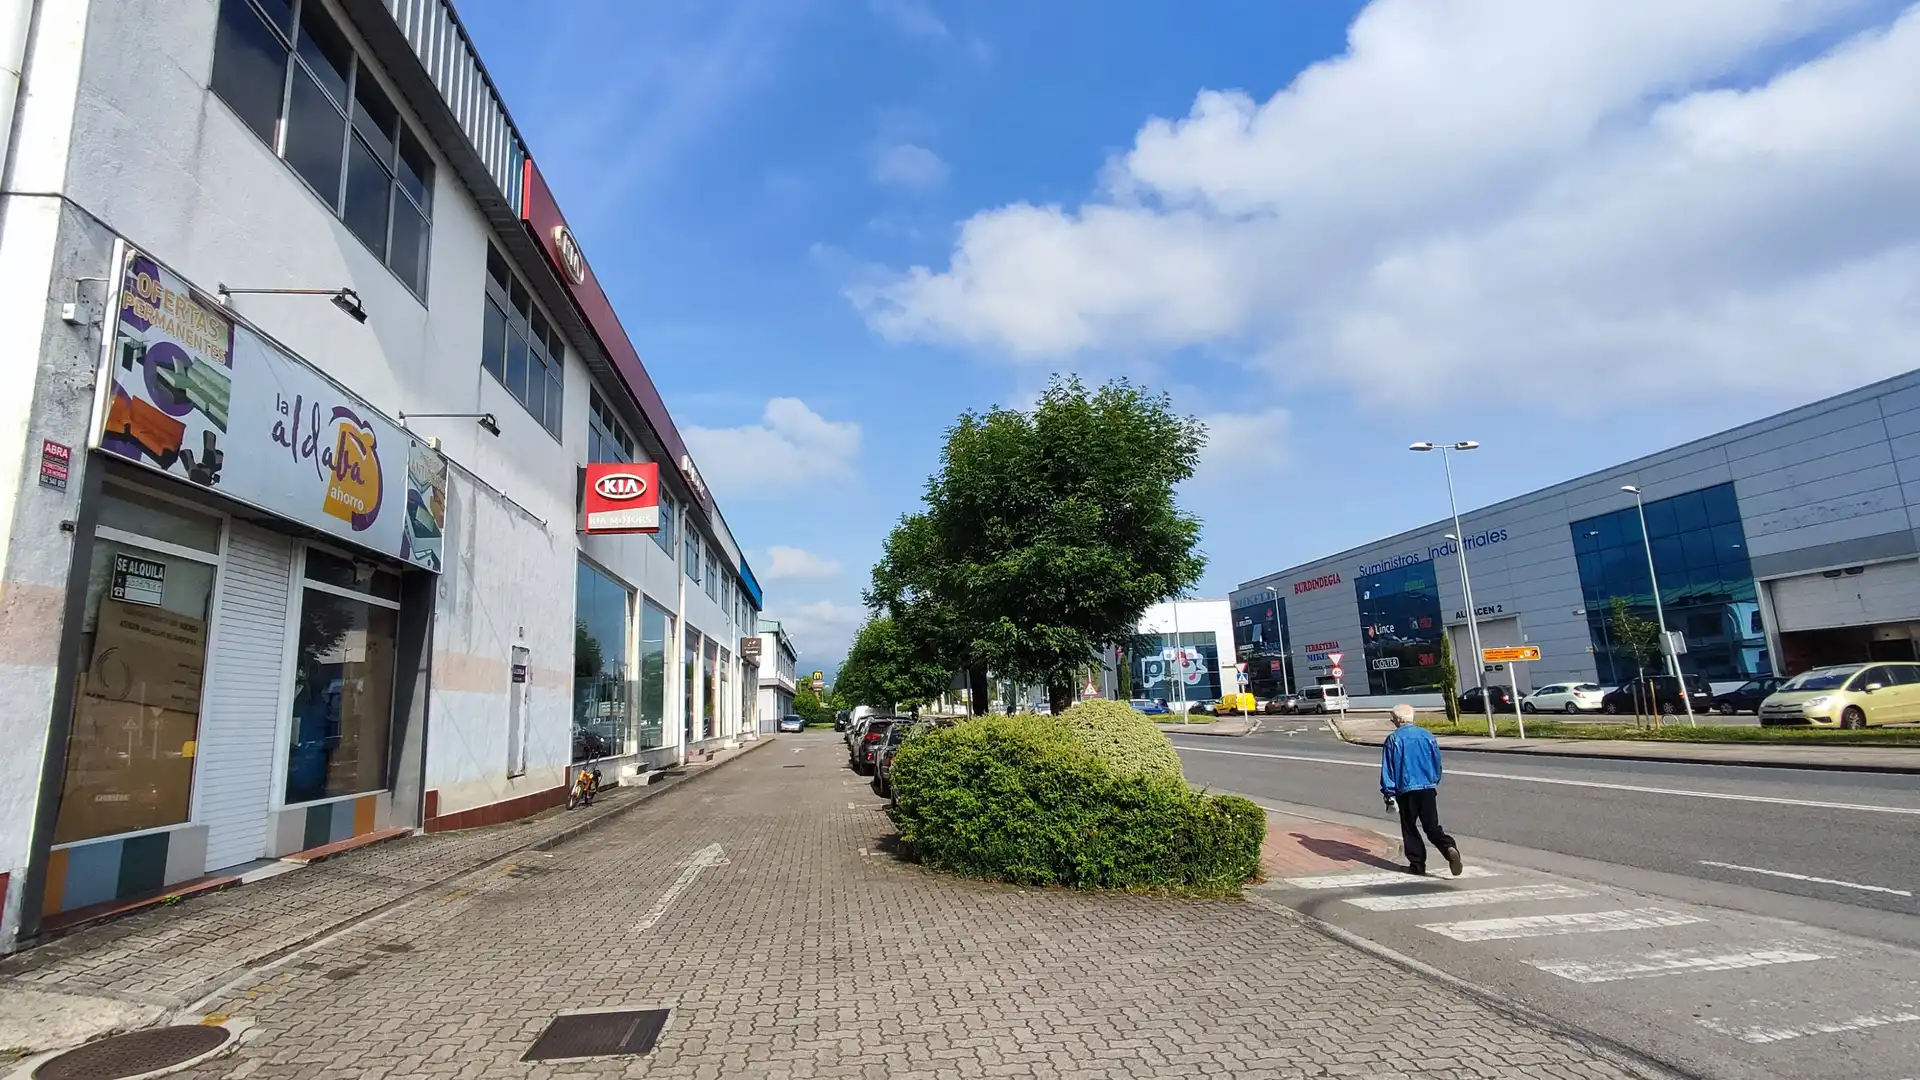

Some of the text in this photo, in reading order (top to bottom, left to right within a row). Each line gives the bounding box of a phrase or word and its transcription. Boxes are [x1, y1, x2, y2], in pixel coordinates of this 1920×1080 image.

[136, 272, 220, 341] OFERTAS
[122, 291, 227, 365] PERMANENTES
[277, 393, 288, 416] la
[272, 395, 365, 485] aldaba
[45, 443, 69, 459] ABRA
[604, 479, 638, 493] KIA
[331, 486, 364, 511] ahorro
[590, 515, 652, 525] KIA MOTORS
[1359, 528, 1508, 576] Suministros Indutriales
[117, 558, 163, 579] SE ALQUILA
[1294, 573, 1341, 595] BURDINDEGIA
[1455, 604, 1503, 619] ALACEN 2
[1374, 624, 1395, 635] Lince
[1305, 641, 1339, 652] FERRETERIA
